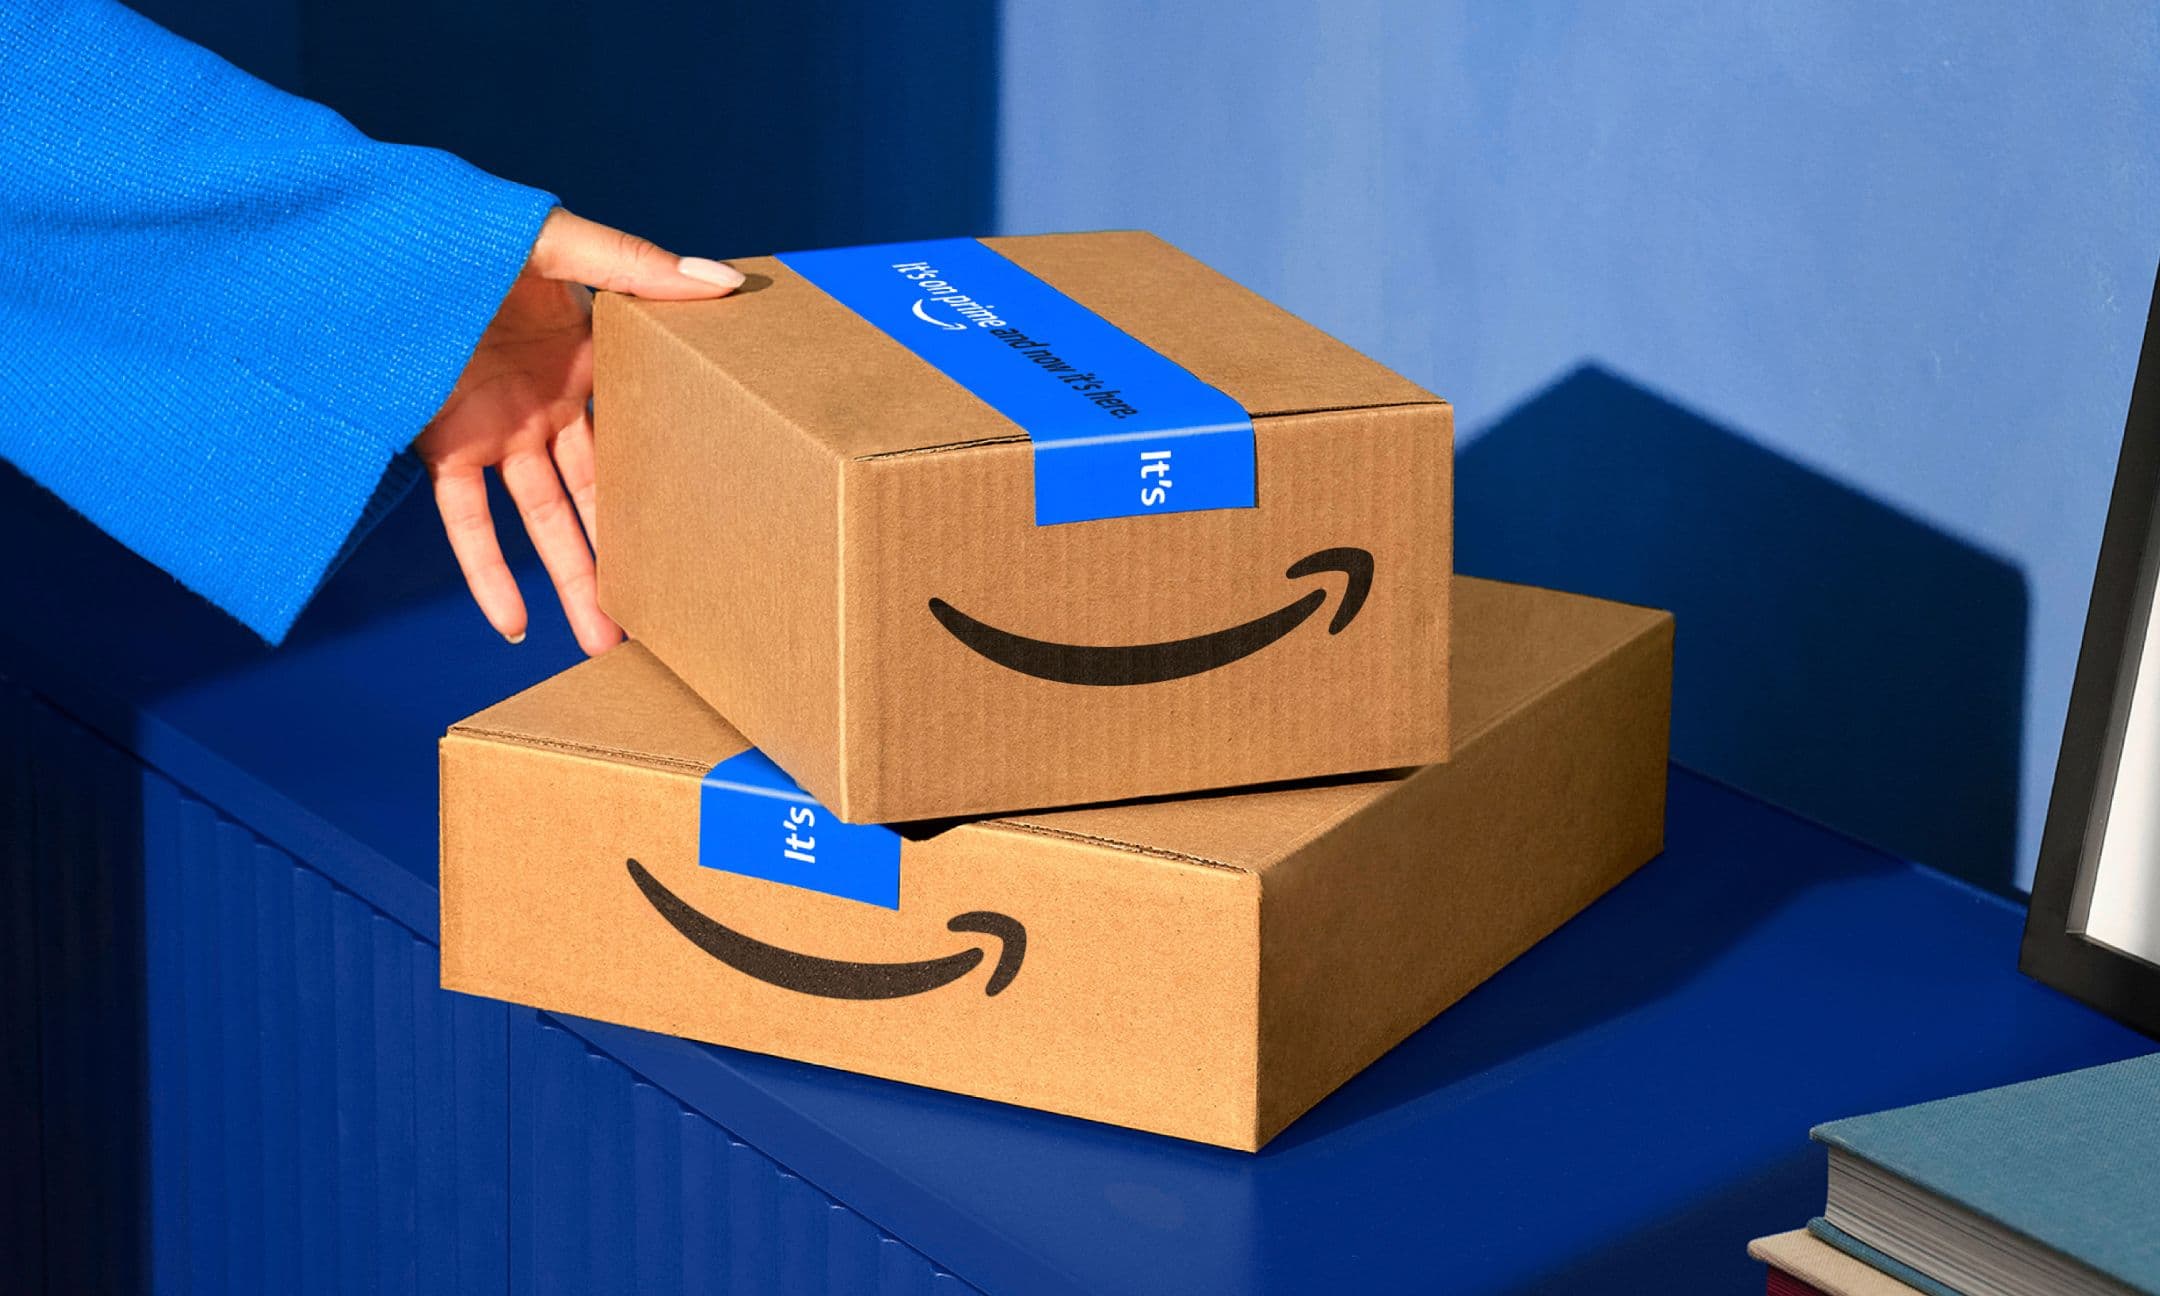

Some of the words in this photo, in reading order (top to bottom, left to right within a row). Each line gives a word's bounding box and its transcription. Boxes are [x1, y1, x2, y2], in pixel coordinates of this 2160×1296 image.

[892, 262, 939, 280] It's
[918, 280, 958, 295] on
[930, 295, 1007, 328] prime
[989, 328, 1051, 349] and
[1021, 349, 1077, 373] now
[1056, 372, 1105, 391] it's
[1083, 390, 1139, 420] here.
[1140, 450, 1173, 506] It's
[783, 806, 816, 864] It's
